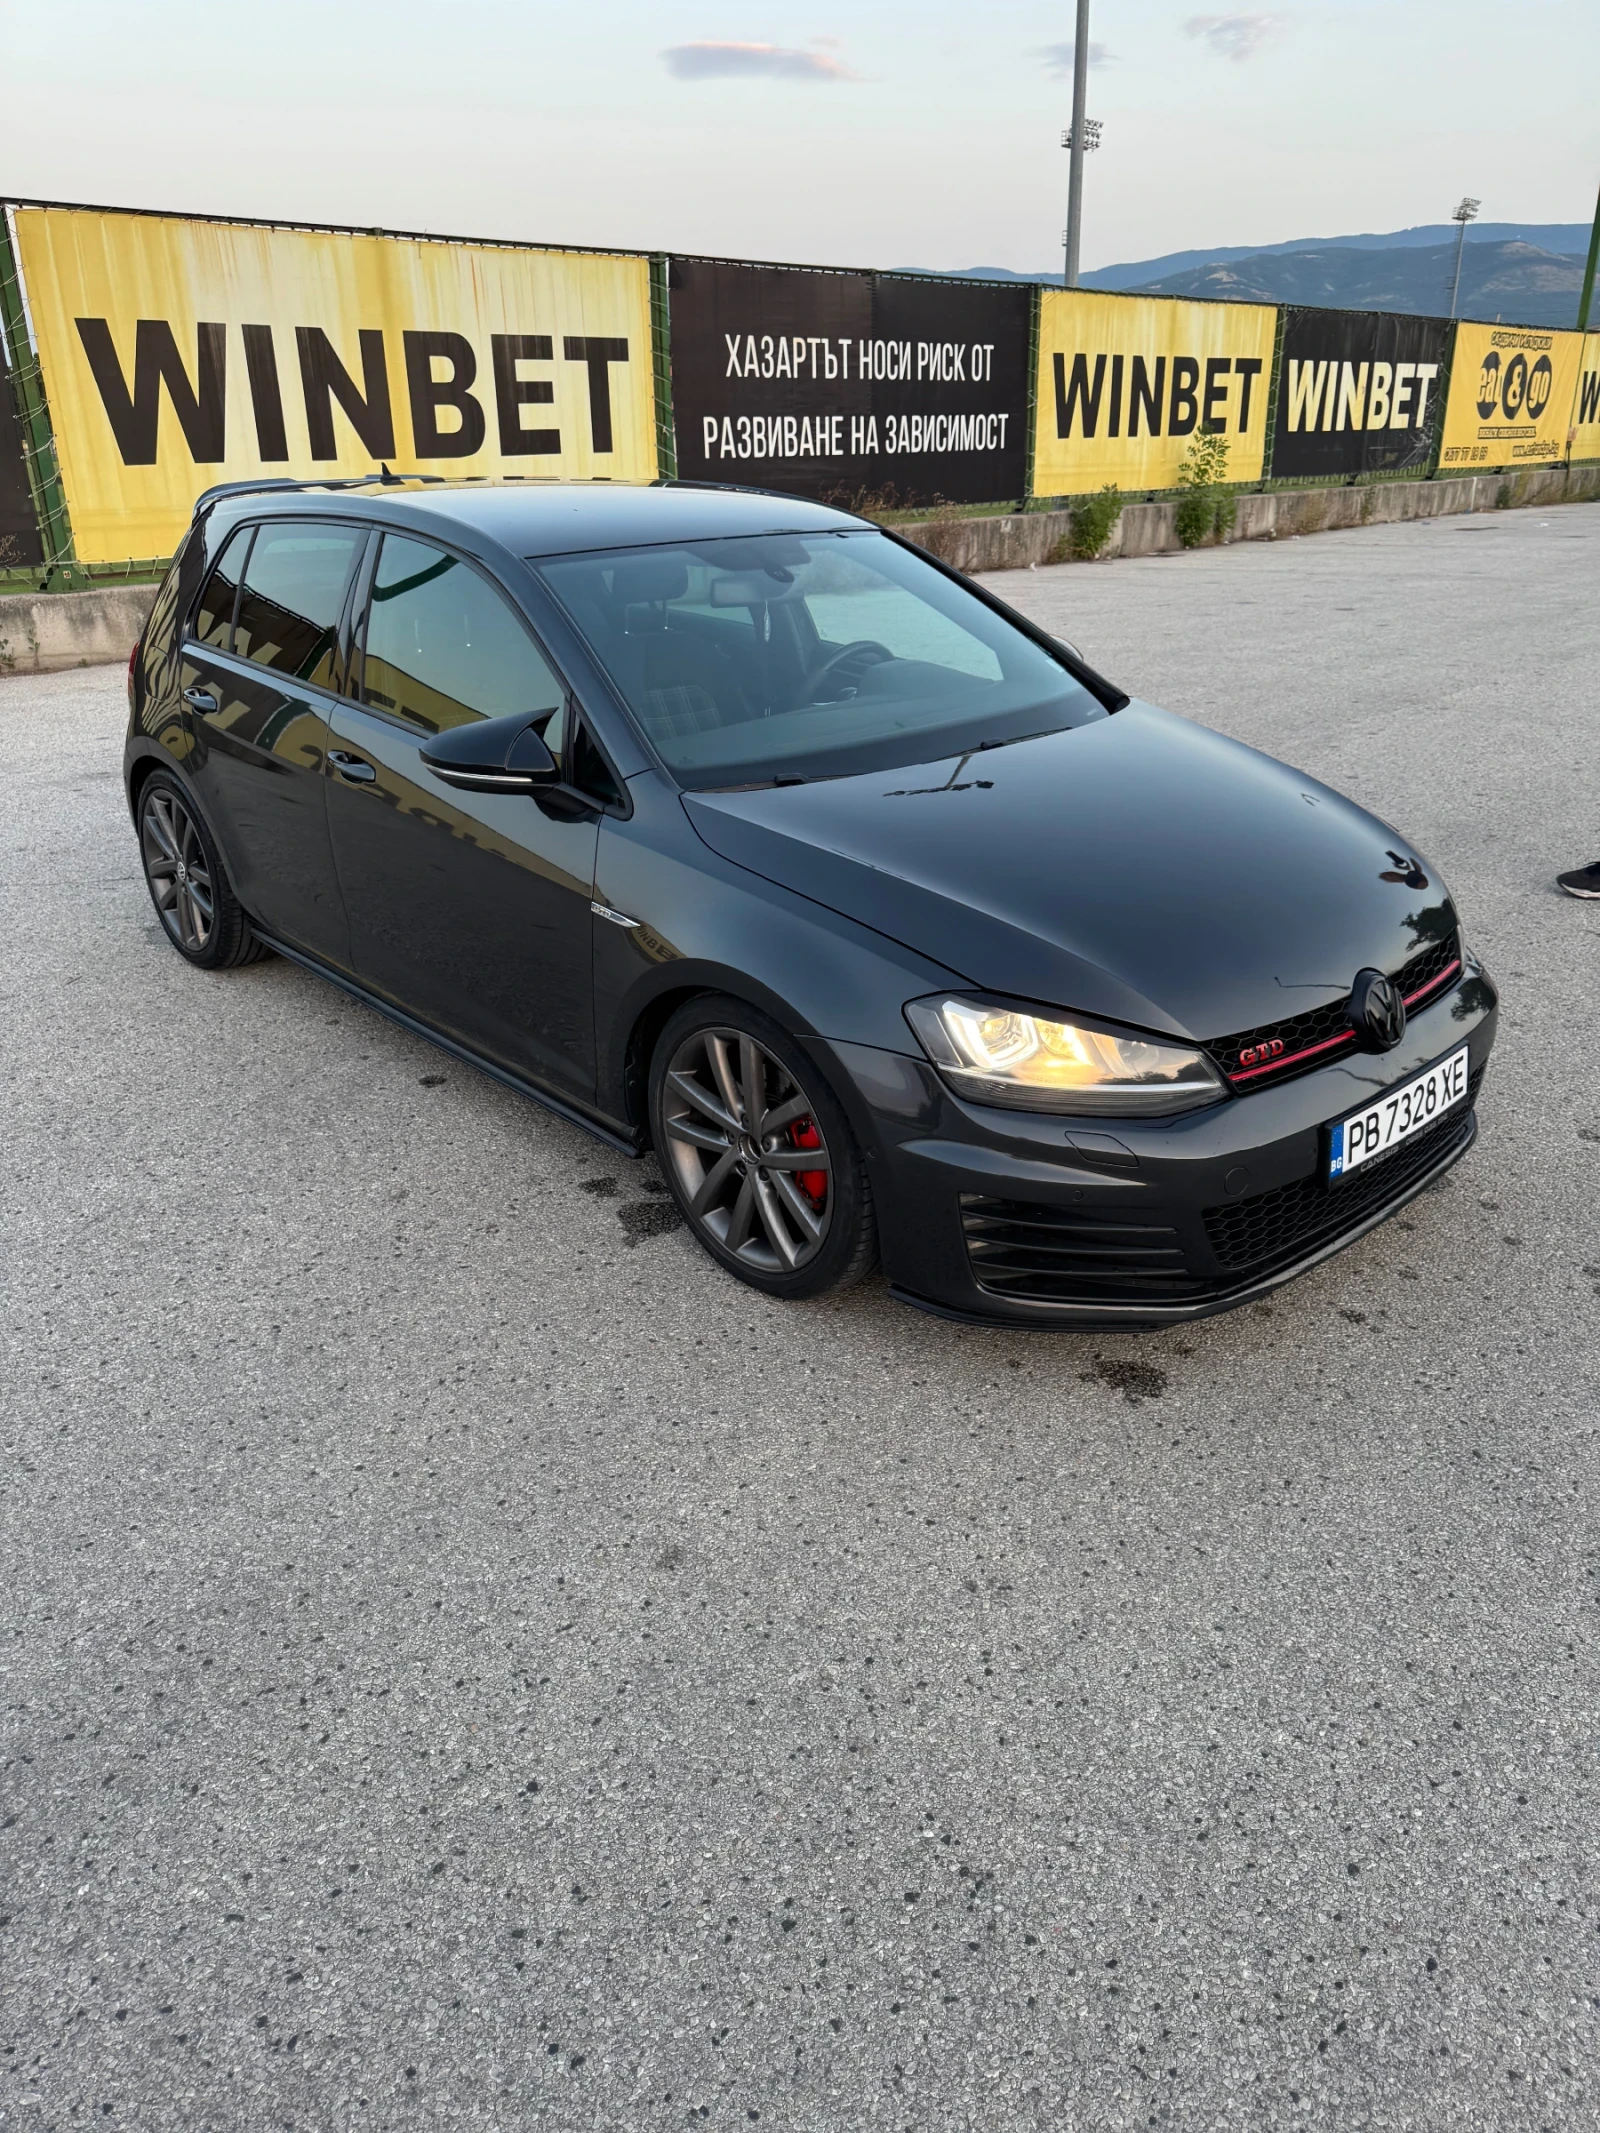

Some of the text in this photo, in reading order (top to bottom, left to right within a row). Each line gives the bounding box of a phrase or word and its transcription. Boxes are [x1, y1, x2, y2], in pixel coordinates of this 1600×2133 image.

[725, 333, 994, 381] ХАЗАРТЪТ НОСИ РИСК ОТ
[75, 318, 628, 466] WINBET
[1052, 352, 1263, 439] WINBET
[1288, 358, 1439, 432] WINBET
[1527, 370, 1550, 409] go
[703, 413, 1009, 459] РАЗВИВАНЕ НА ЗАВИСИМОСТ
[1239, 1039, 1284, 1067] GTD
[1348, 1112, 1380, 1164] PB
[1385, 1076, 1437, 1146] 7328
[1441, 1055, 1465, 1108] XE
[1331, 1156, 1343, 1173] BG
